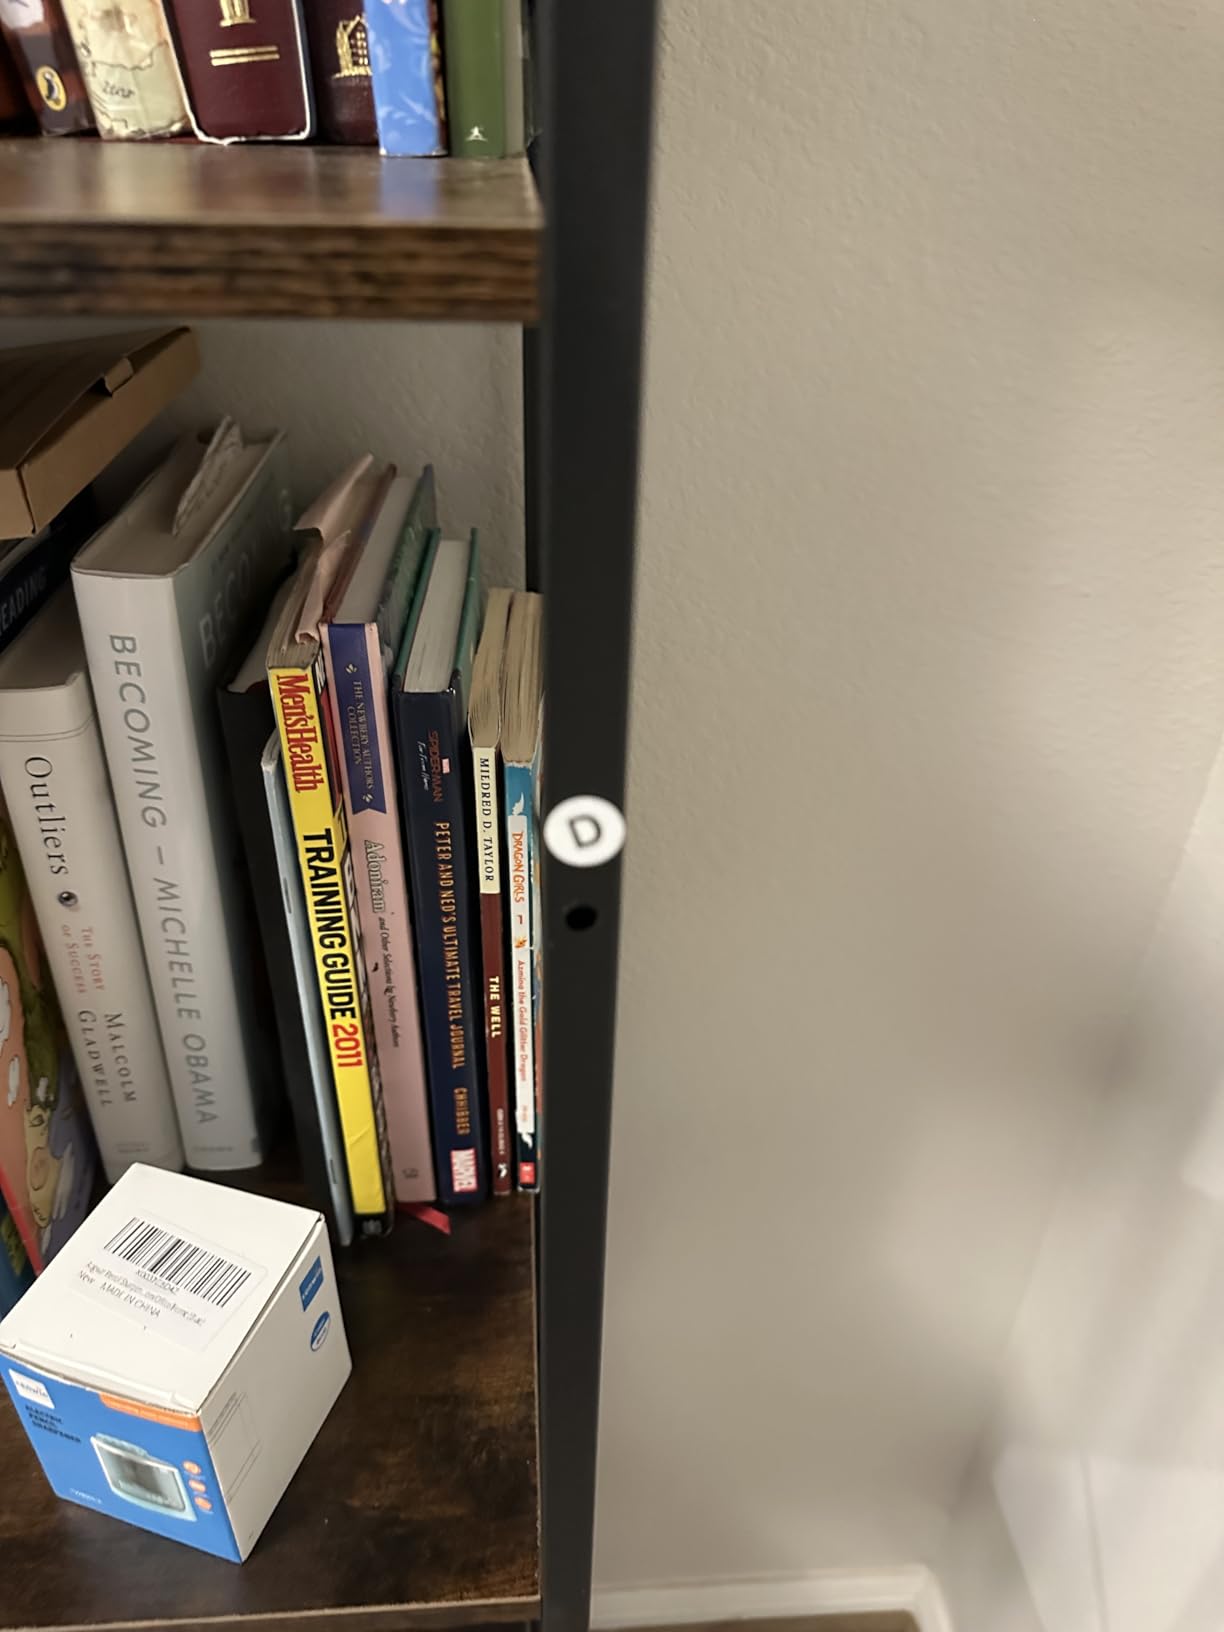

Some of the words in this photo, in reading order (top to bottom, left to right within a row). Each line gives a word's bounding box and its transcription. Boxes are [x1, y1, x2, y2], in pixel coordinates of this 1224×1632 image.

[353, 679, 364, 699] THE
[346, 705, 362, 765] COLLECTION
[355, 702, 369, 744] NEWBERY
[361, 748, 374, 790] AUTHORS
[479, 757, 492, 817] MILDRED
[24, 756, 69, 875] Outliers
[482, 821, 492, 833] D.
[568, 813, 602, 848] D
[434, 822, 452, 860] PETER
[483, 836, 494, 882] TAYLOR
[511, 831, 524, 873] DRAGON
[109, 634, 167, 828] BECOMING
[153, 877, 202, 1021] MICHELLE
[181, 1033, 219, 1125] OBAMA
[303, 827, 347, 950] TRAINING
[364, 839, 386, 914] Adoniram
[438, 863, 454, 888] AND
[513, 874, 525, 904] GIRLS
[378, 916, 387, 931] and
[440, 890, 457, 923] NED'S
[379, 931, 390, 952] Other
[442, 925, 461, 981] ULTIMATE
[88, 952, 105, 991] STORY
[322, 952, 357, 1021] GUIDE
[488, 975, 500, 1002] THE
[447, 983, 463, 1021] TRAVEL
[518, 991, 527, 1005] the
[519, 1006, 528, 1025] Gold
[490, 1004, 501, 1038] WELL
[519, 1026, 528, 1052] Glitter
[78, 1009, 113, 1107] GLADWELL
[104, 1012, 137, 1103] MALCOLM
[332, 1023, 363, 1068] 2011
[450, 1023, 465, 1069] JOURNAL
[519, 1053, 529, 1083] Dragon
[100, 1281, 124, 1299] MADE
[134, 1298, 161, 1318] CHINA
